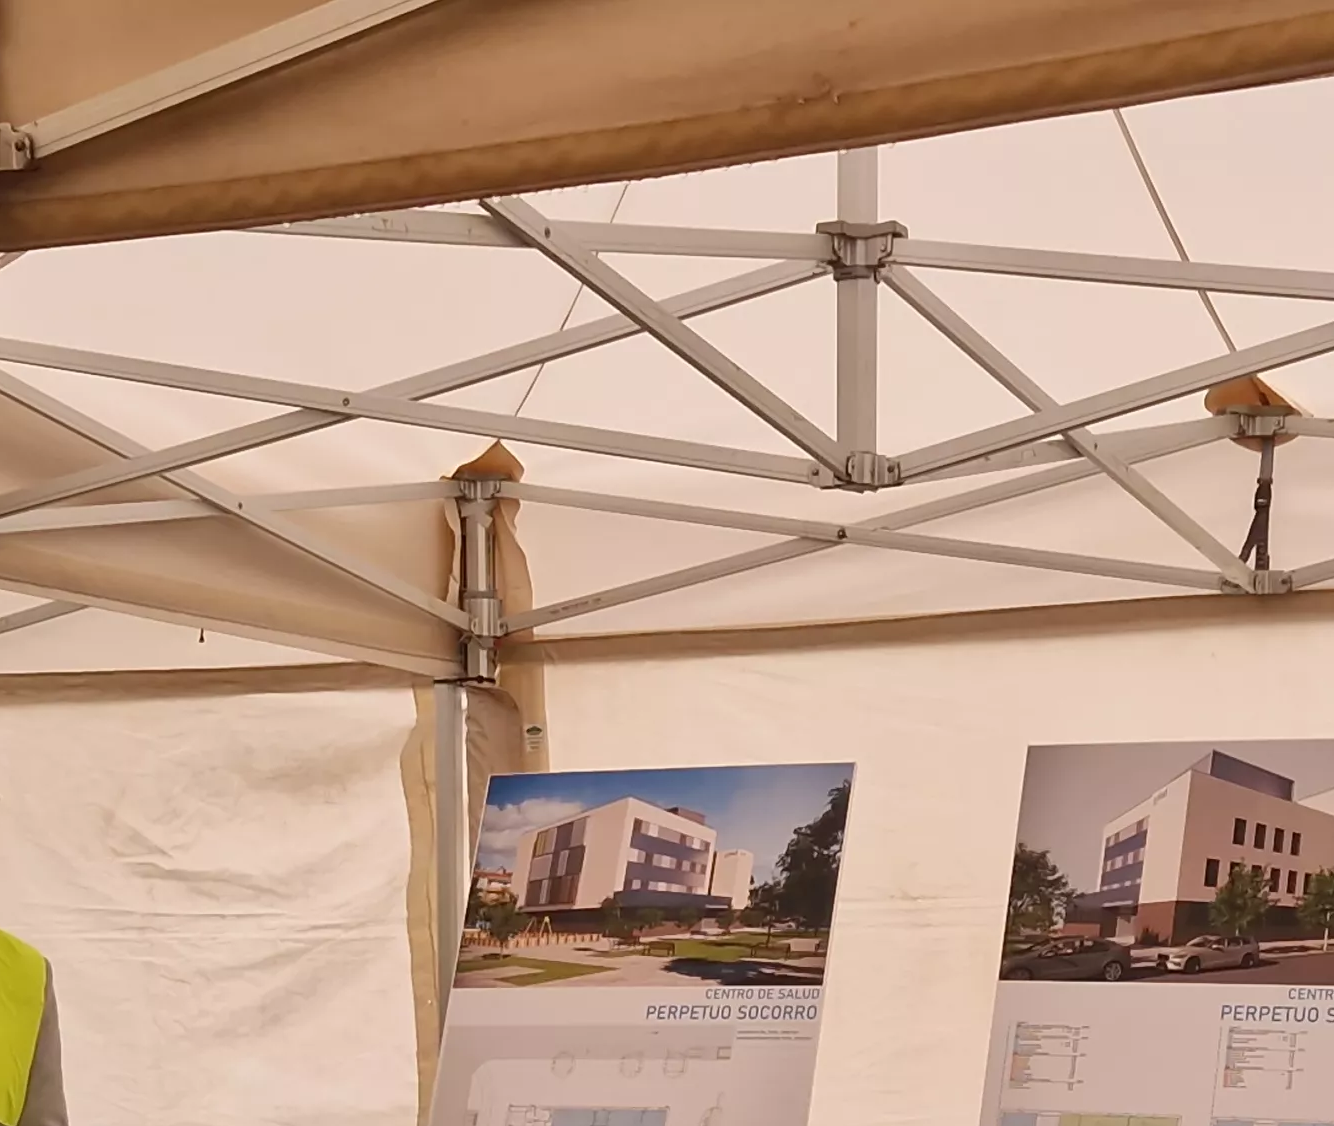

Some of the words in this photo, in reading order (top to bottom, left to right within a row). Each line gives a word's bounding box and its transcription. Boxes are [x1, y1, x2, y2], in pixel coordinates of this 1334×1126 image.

[705, 988, 754, 1000] CENTRO
[758, 988, 774, 1000] DE
[777, 988, 820, 1000] SALUD
[646, 1005, 732, 1020] PERPETUO
[736, 1005, 818, 1020] SOCORRO
[1220, 1004, 1319, 1023] PERPETUO
